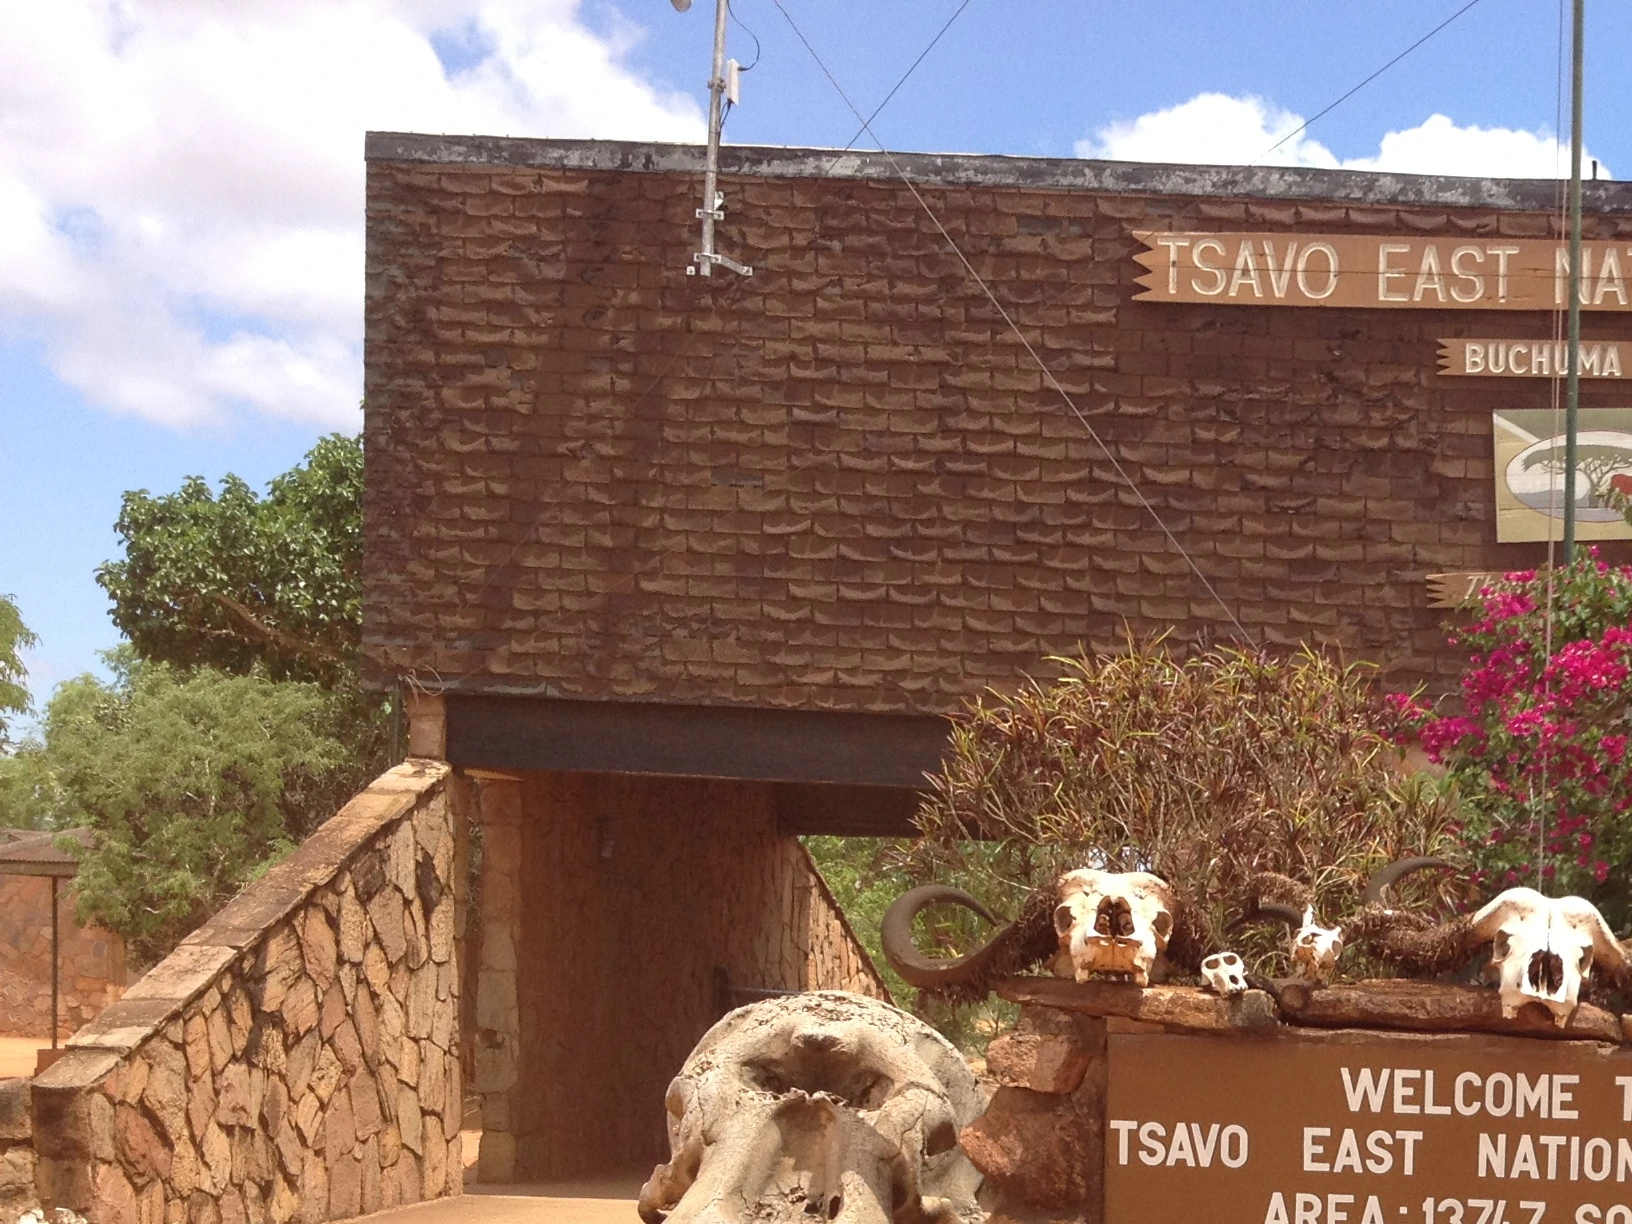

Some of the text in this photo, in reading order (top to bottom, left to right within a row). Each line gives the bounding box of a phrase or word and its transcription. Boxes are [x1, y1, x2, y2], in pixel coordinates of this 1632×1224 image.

[1156, 236, 1339, 300] TSAVO
[1379, 245, 1519, 302] EAST
[1341, 1068, 1579, 1119] WELCOME
[1110, 1120, 1248, 1168] TSAVO
[1304, 1127, 1423, 1175] EAST
